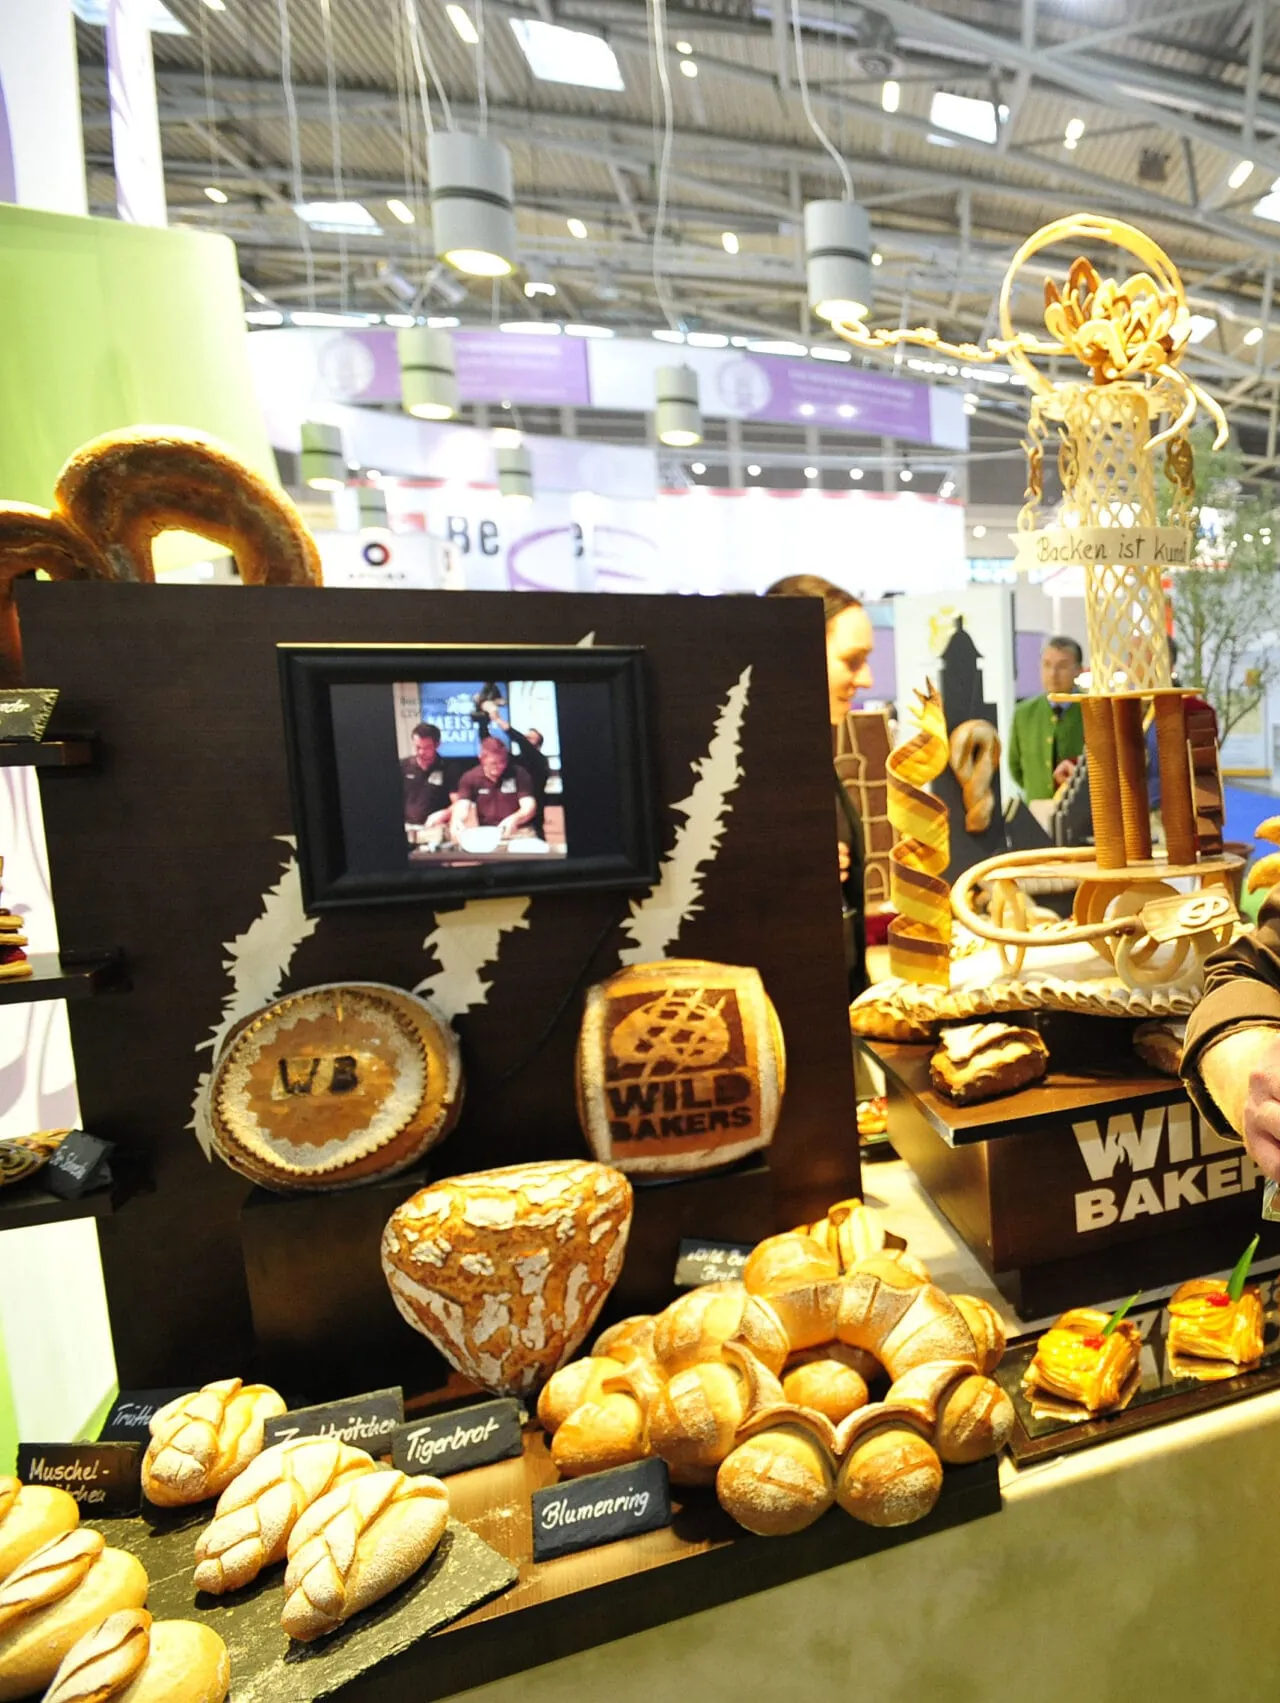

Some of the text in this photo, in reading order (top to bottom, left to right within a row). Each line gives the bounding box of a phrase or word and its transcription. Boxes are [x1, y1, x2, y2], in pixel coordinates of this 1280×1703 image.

[1037, 534, 1107, 562] Backen
[1118, 534, 1145, 560] ist
[606, 1074, 752, 1117] WILD
[609, 1107, 753, 1142] BAKERS
[1071, 1102, 1246, 1182] WIL
[1074, 1154, 1265, 1233] BAKER
[406, 1417, 499, 1464] Tigerbrot
[29, 1457, 110, 1480] Muschel-
[541, 1486, 650, 1530] Blumenring
